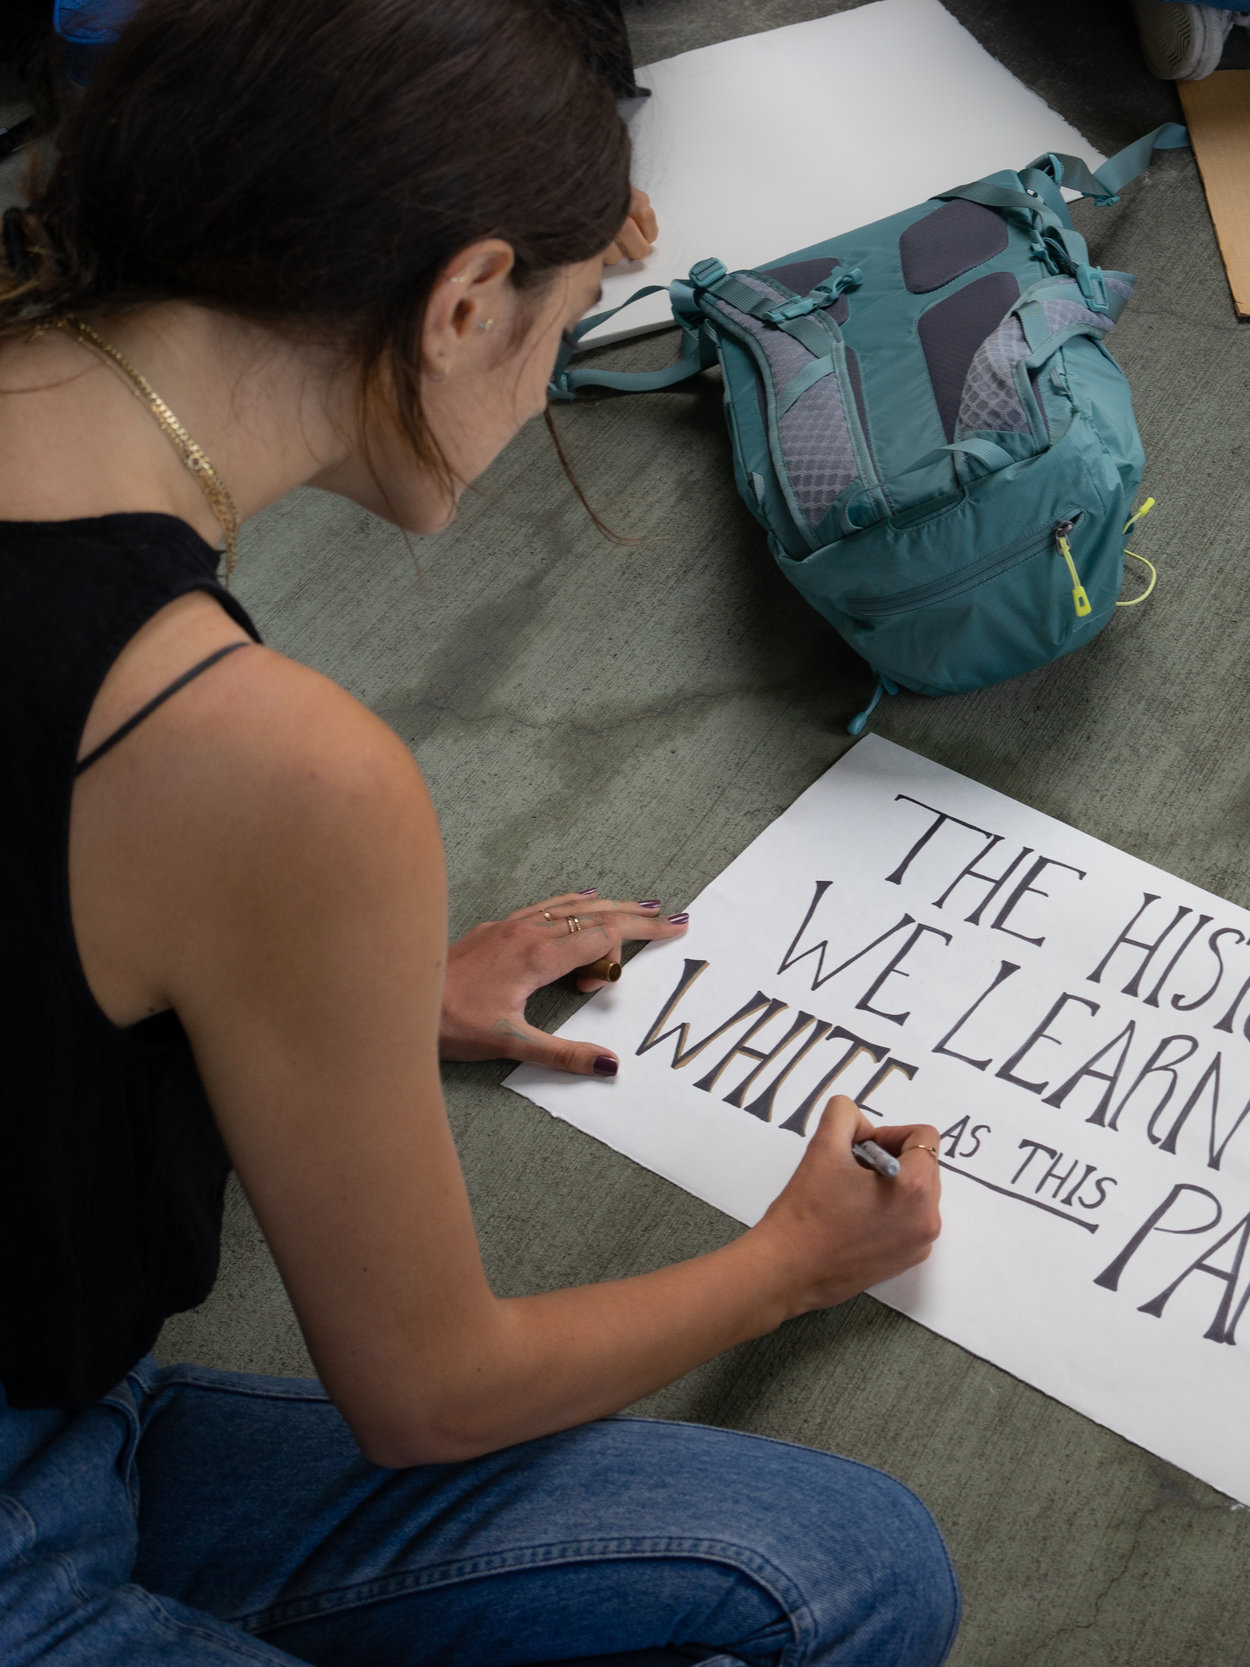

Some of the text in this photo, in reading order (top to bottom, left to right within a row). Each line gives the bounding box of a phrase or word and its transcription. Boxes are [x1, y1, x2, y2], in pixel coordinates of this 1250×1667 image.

[885, 794, 1087, 947] THE
[777, 880, 952, 1026] WE
[635, 958, 919, 1137] WHITE
[939, 1115, 991, 1159] AS
[1010, 1138, 1117, 1209] THIS
